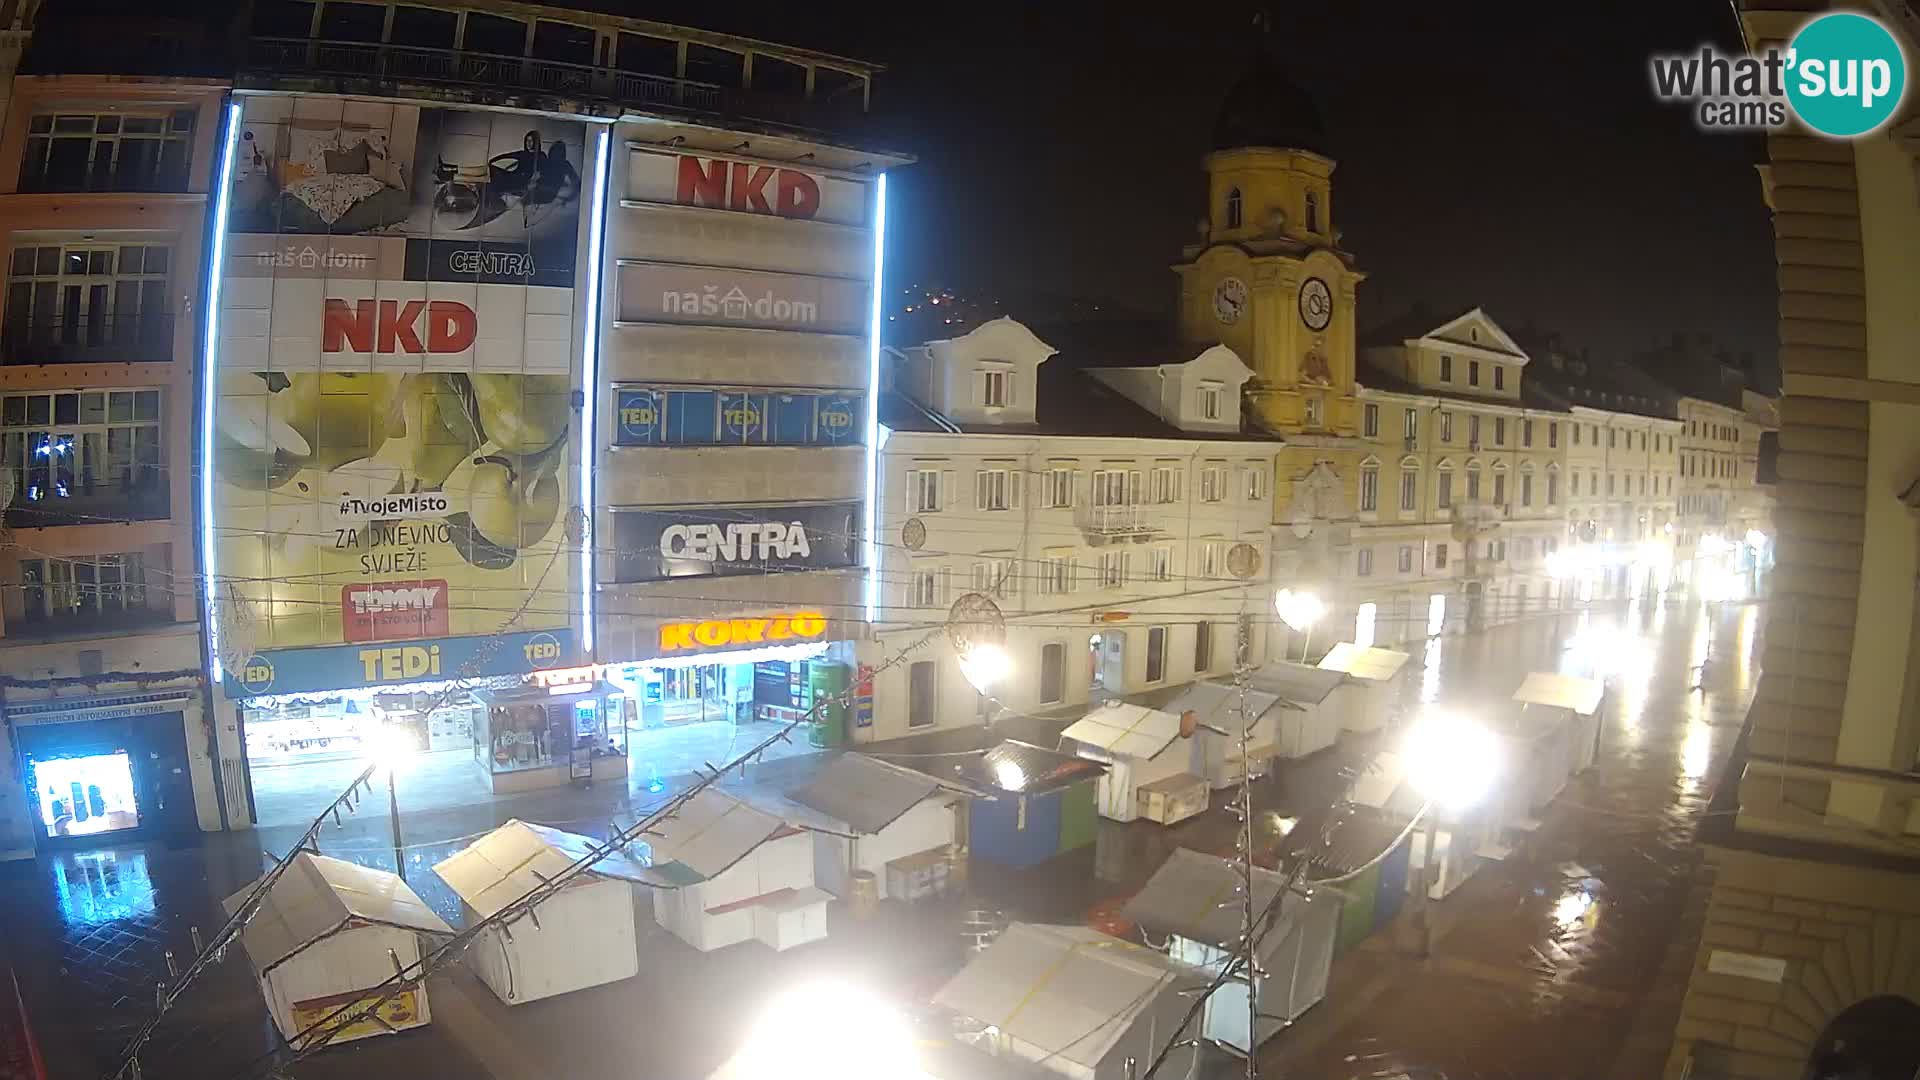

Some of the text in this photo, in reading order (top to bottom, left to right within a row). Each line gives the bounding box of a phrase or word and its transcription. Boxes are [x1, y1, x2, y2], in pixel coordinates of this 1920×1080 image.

[676, 155, 820, 219] NKD
[257, 245, 367, 269] naš dom
[449, 250, 535, 276] CENTRA
[662, 280, 816, 323] naš dom
[323, 298, 478, 353] NKD
[622, 407, 658, 425] TEDi
[724, 409, 760, 426] TEDi
[340, 497, 447, 516] #TvojeMisto
[335, 524, 451, 549] ZA DNEVNO
[660, 521, 811, 562] CENTRA
[361, 547, 428, 575] SVJEŽE
[660, 611, 827, 650] KORZO
[360, 644, 440, 682] TEDi
[523, 643, 561, 659] TEDi
